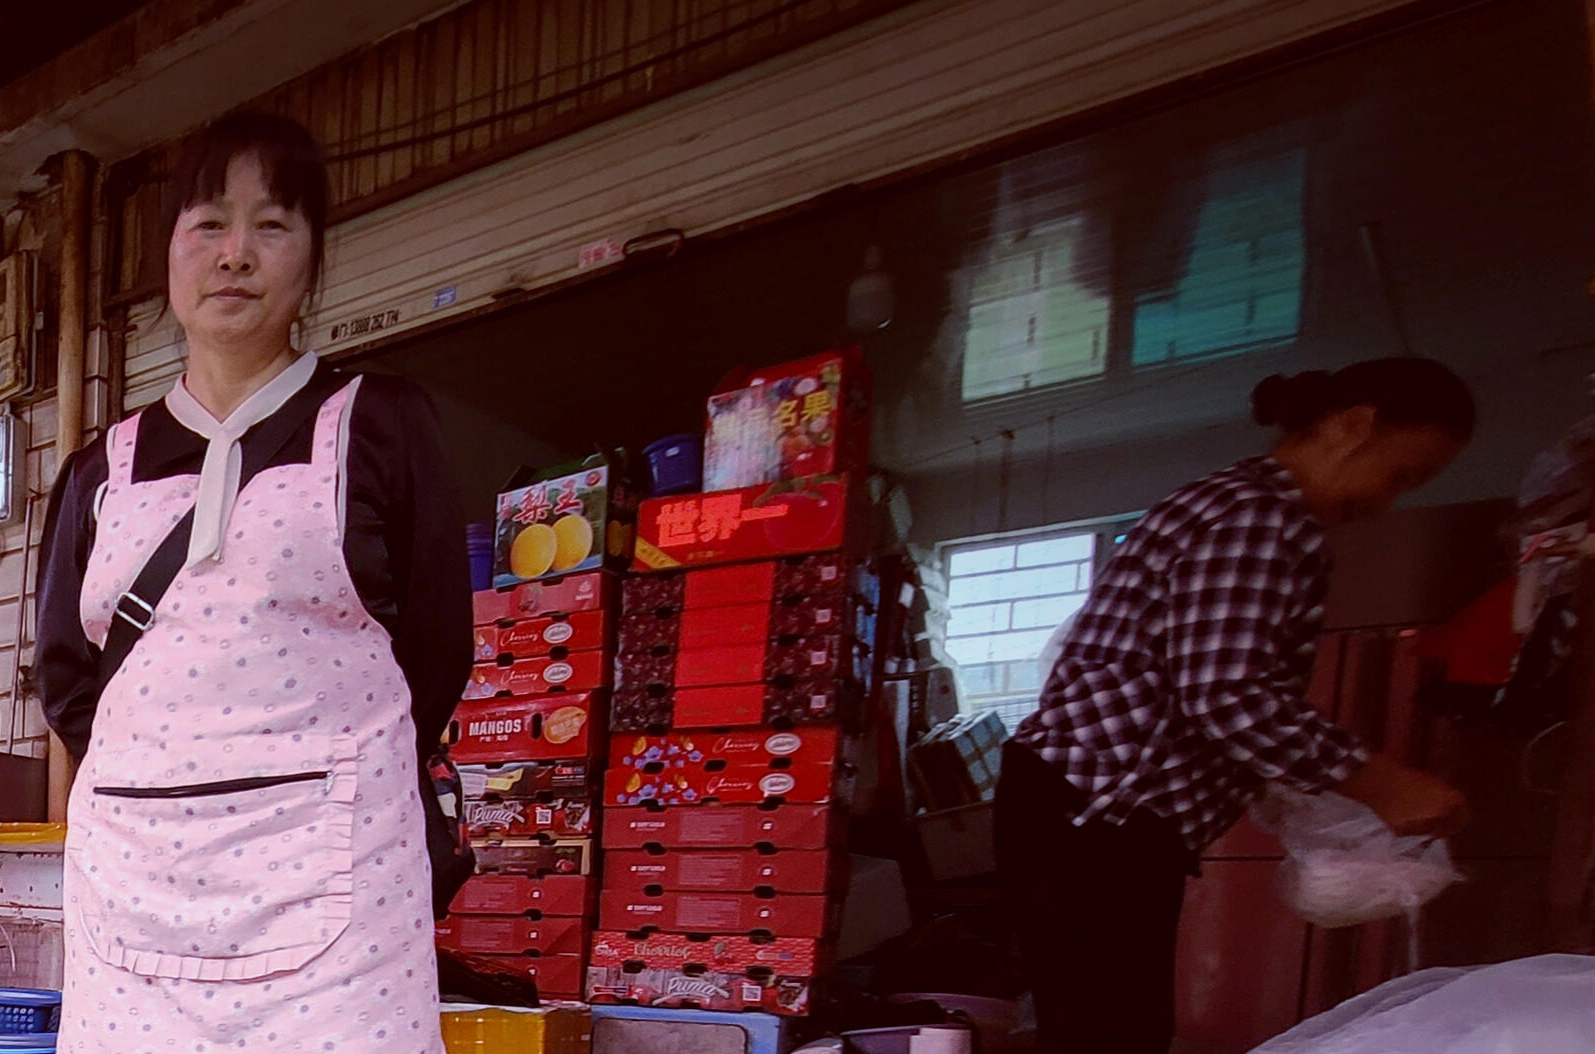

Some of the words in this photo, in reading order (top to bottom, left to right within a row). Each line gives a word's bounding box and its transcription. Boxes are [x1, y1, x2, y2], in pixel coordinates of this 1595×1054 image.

[512, 478, 584, 525] 梨王
[656, 494, 789, 548] 世界一
[468, 718, 522, 737] MANGOS
[474, 808, 514, 825] Puma
[667, 976, 716, 997] Puma
